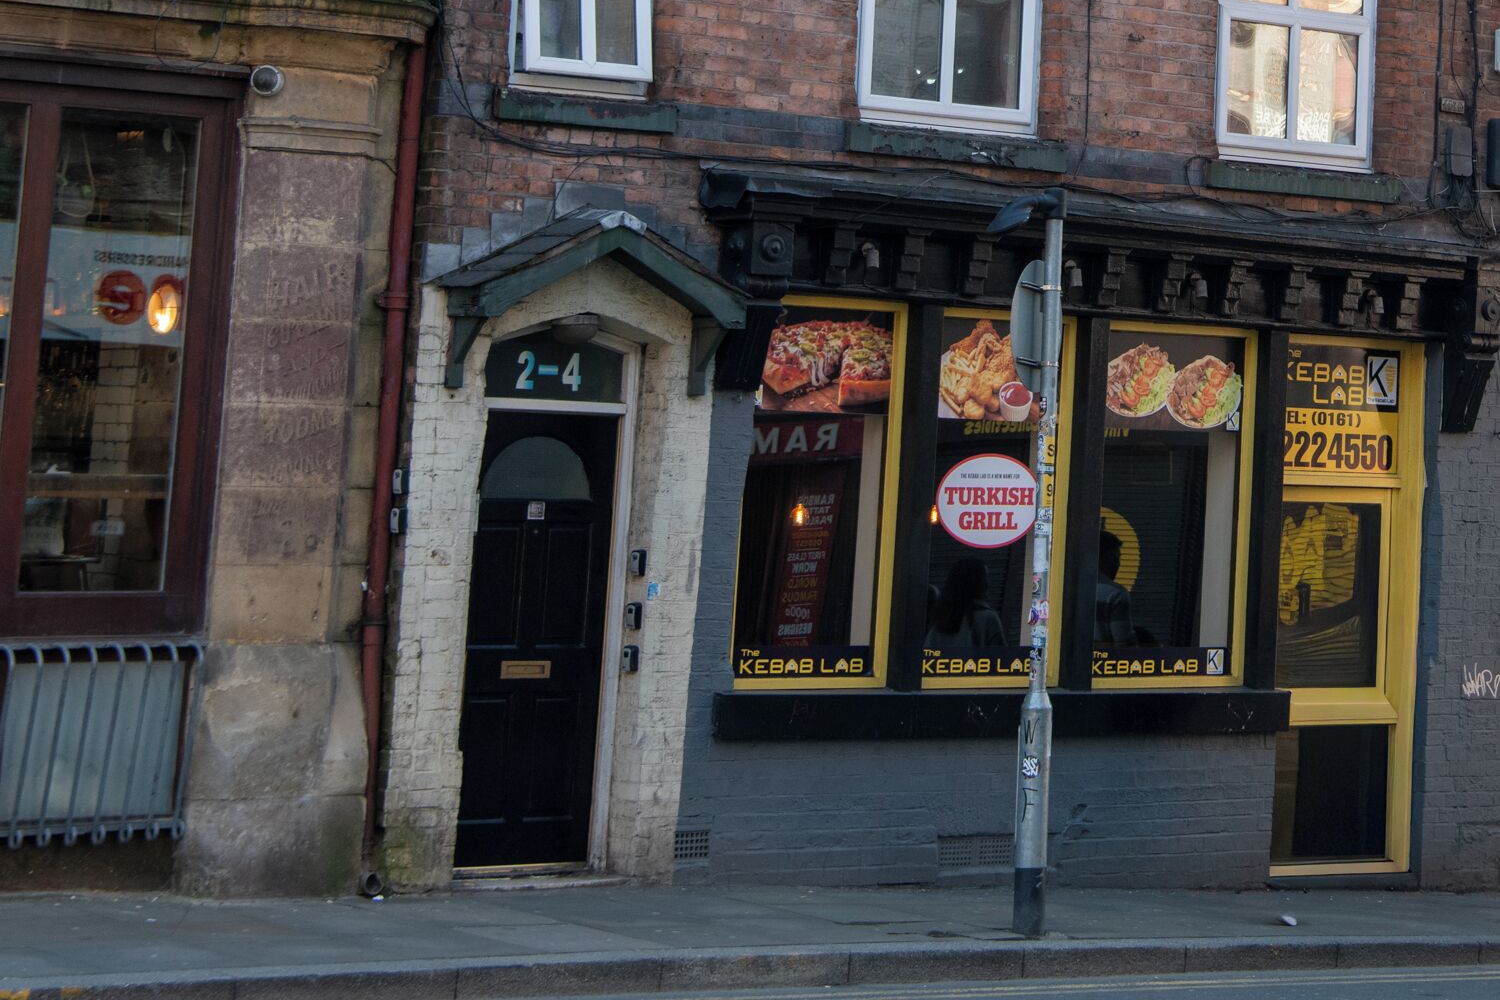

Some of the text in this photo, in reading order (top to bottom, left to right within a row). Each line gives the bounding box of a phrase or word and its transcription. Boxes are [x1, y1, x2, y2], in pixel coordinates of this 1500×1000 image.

[515, 351, 582, 392] 2-4
[1287, 361, 1365, 385] KEBAB
[1313, 384, 1364, 405] LAB
[1286, 410, 1362, 428] EL: (0161)
[1284, 430, 1393, 471] 2224550
[944, 487, 1034, 505] TURKISH
[958, 511, 1018, 530] GRILL
[740, 649, 760, 657] The
[923, 649, 941, 657] The
[739, 658, 864, 674] KEBAB LAB
[921, 658, 991, 674] KEBAB
[1091, 659, 1199, 674] KEBAB LAB
